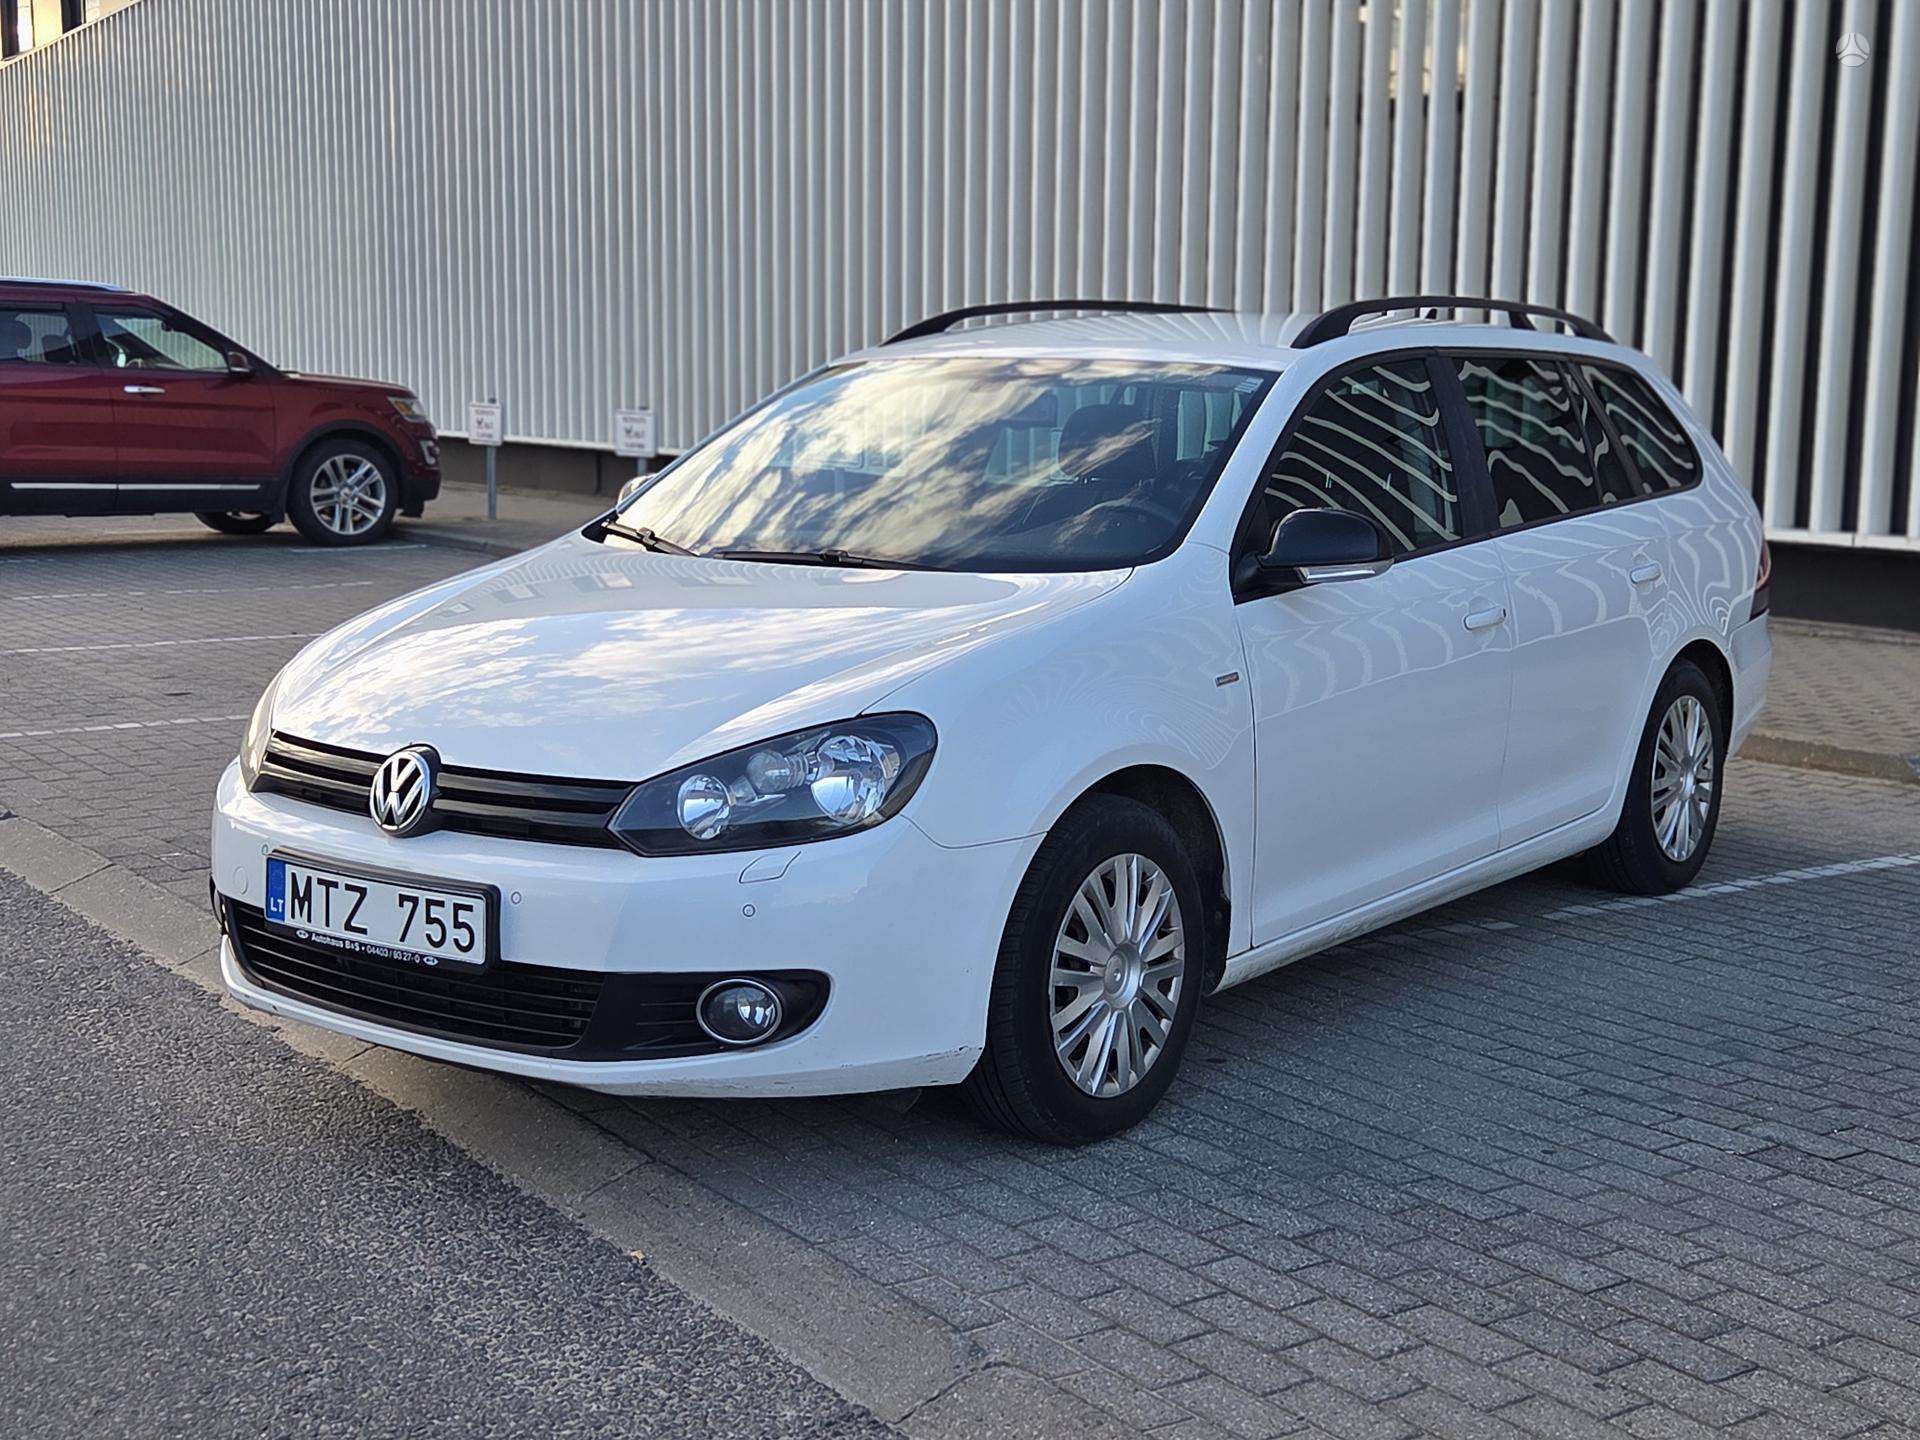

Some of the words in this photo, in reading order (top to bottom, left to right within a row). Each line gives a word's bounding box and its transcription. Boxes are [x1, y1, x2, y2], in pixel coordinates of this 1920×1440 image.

[270, 897, 284, 913] LT
[291, 871, 368, 935] MTZ
[398, 893, 475, 953] 755
[311, 932, 344, 948] Autohaus
